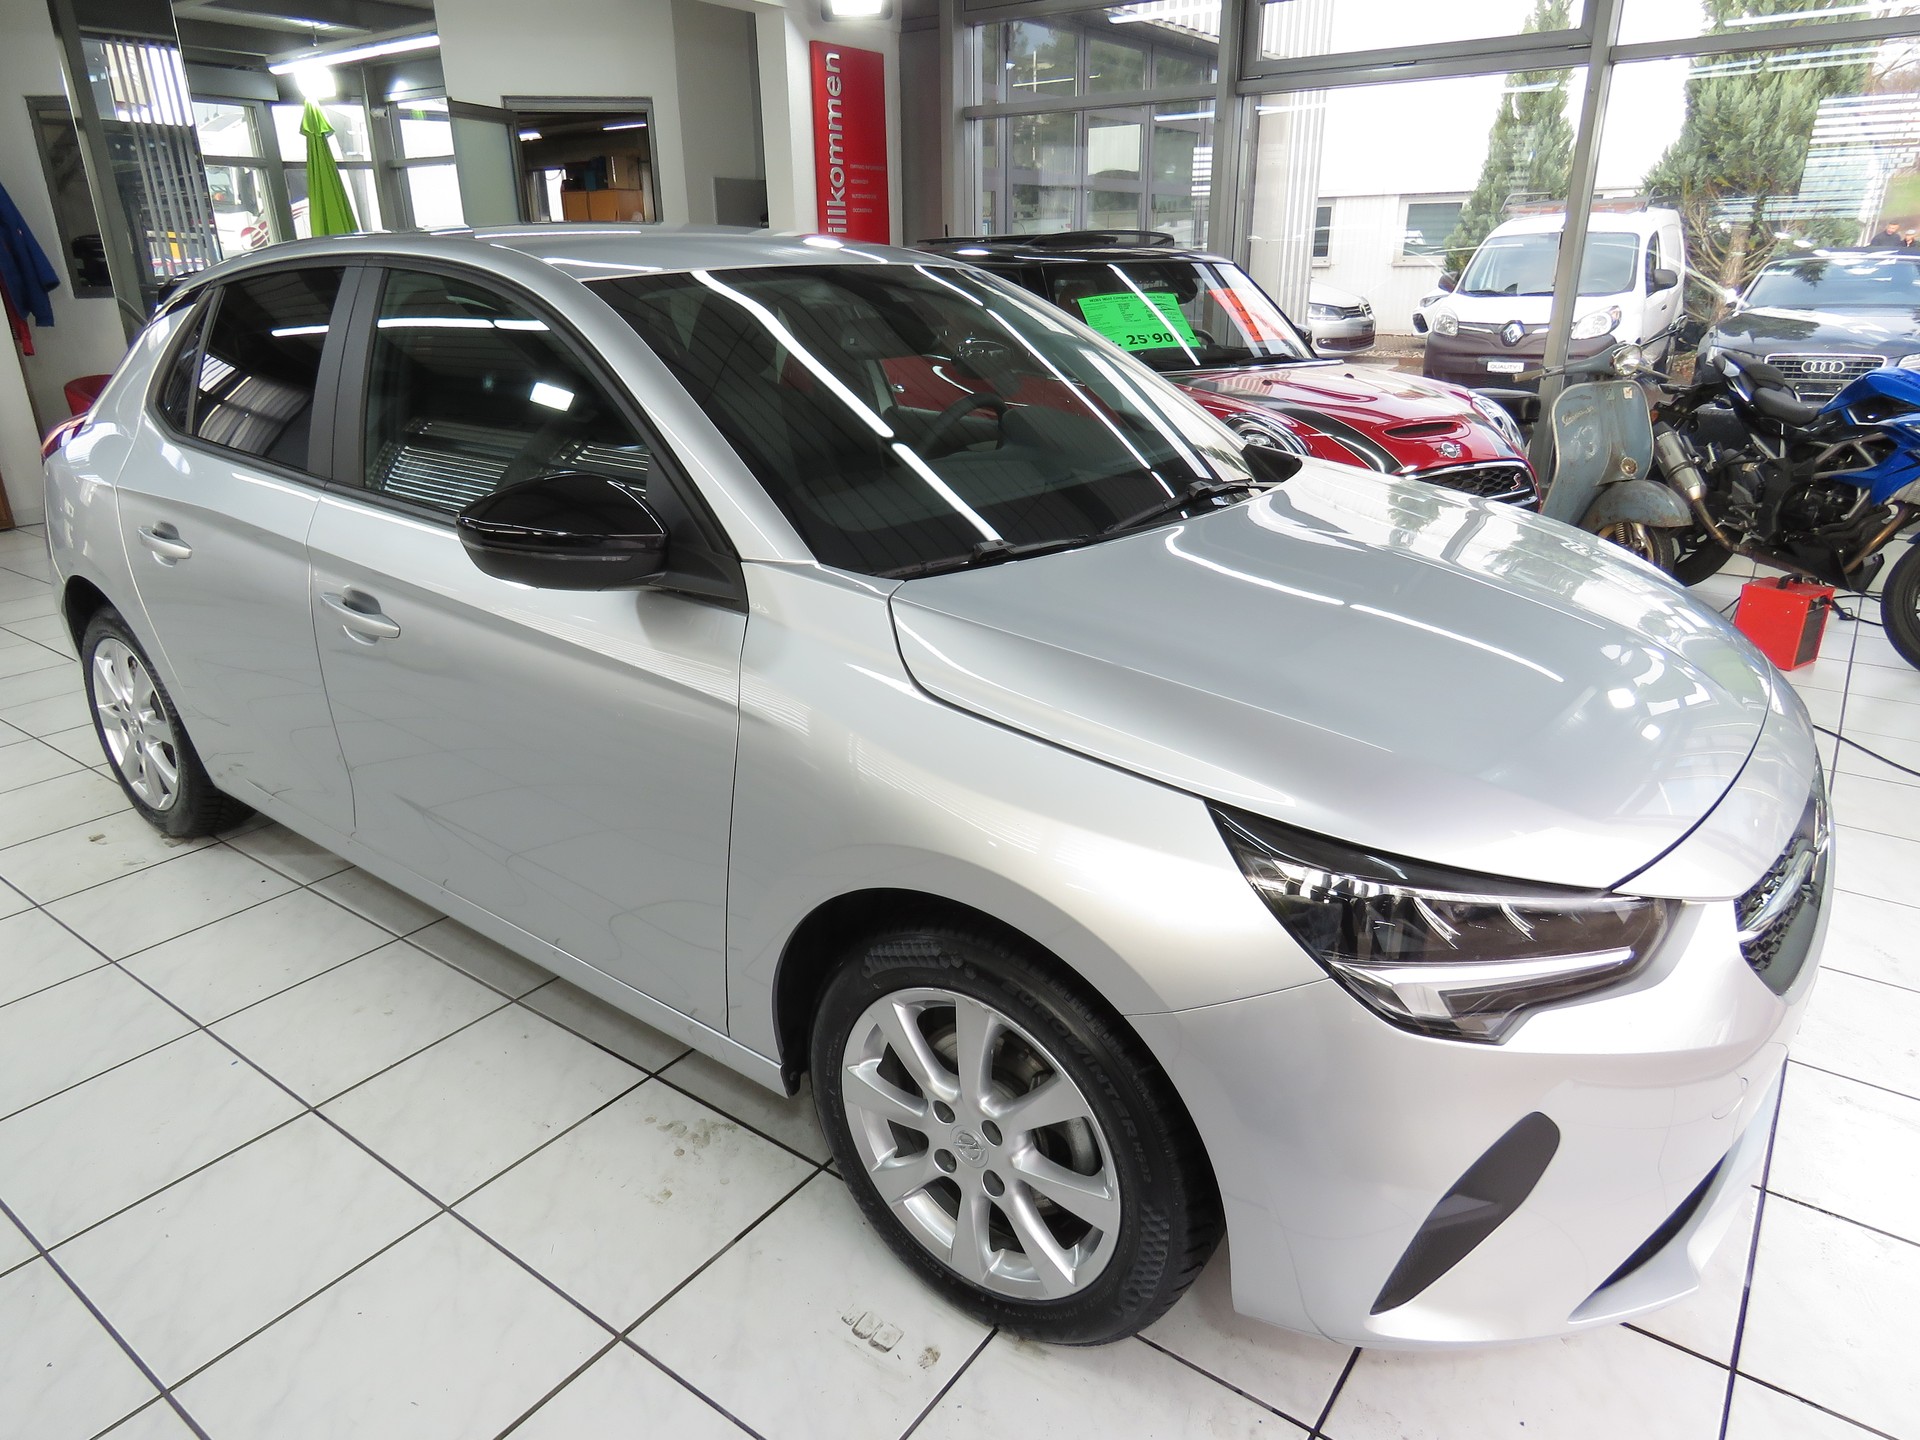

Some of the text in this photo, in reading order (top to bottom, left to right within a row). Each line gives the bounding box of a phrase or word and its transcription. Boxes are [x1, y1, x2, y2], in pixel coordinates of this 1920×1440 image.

[826, 52, 847, 234] illkommen
[1126, 332, 1194, 345] 25'90.-
[1000, 980, 1138, 1138] EUROWINTER
